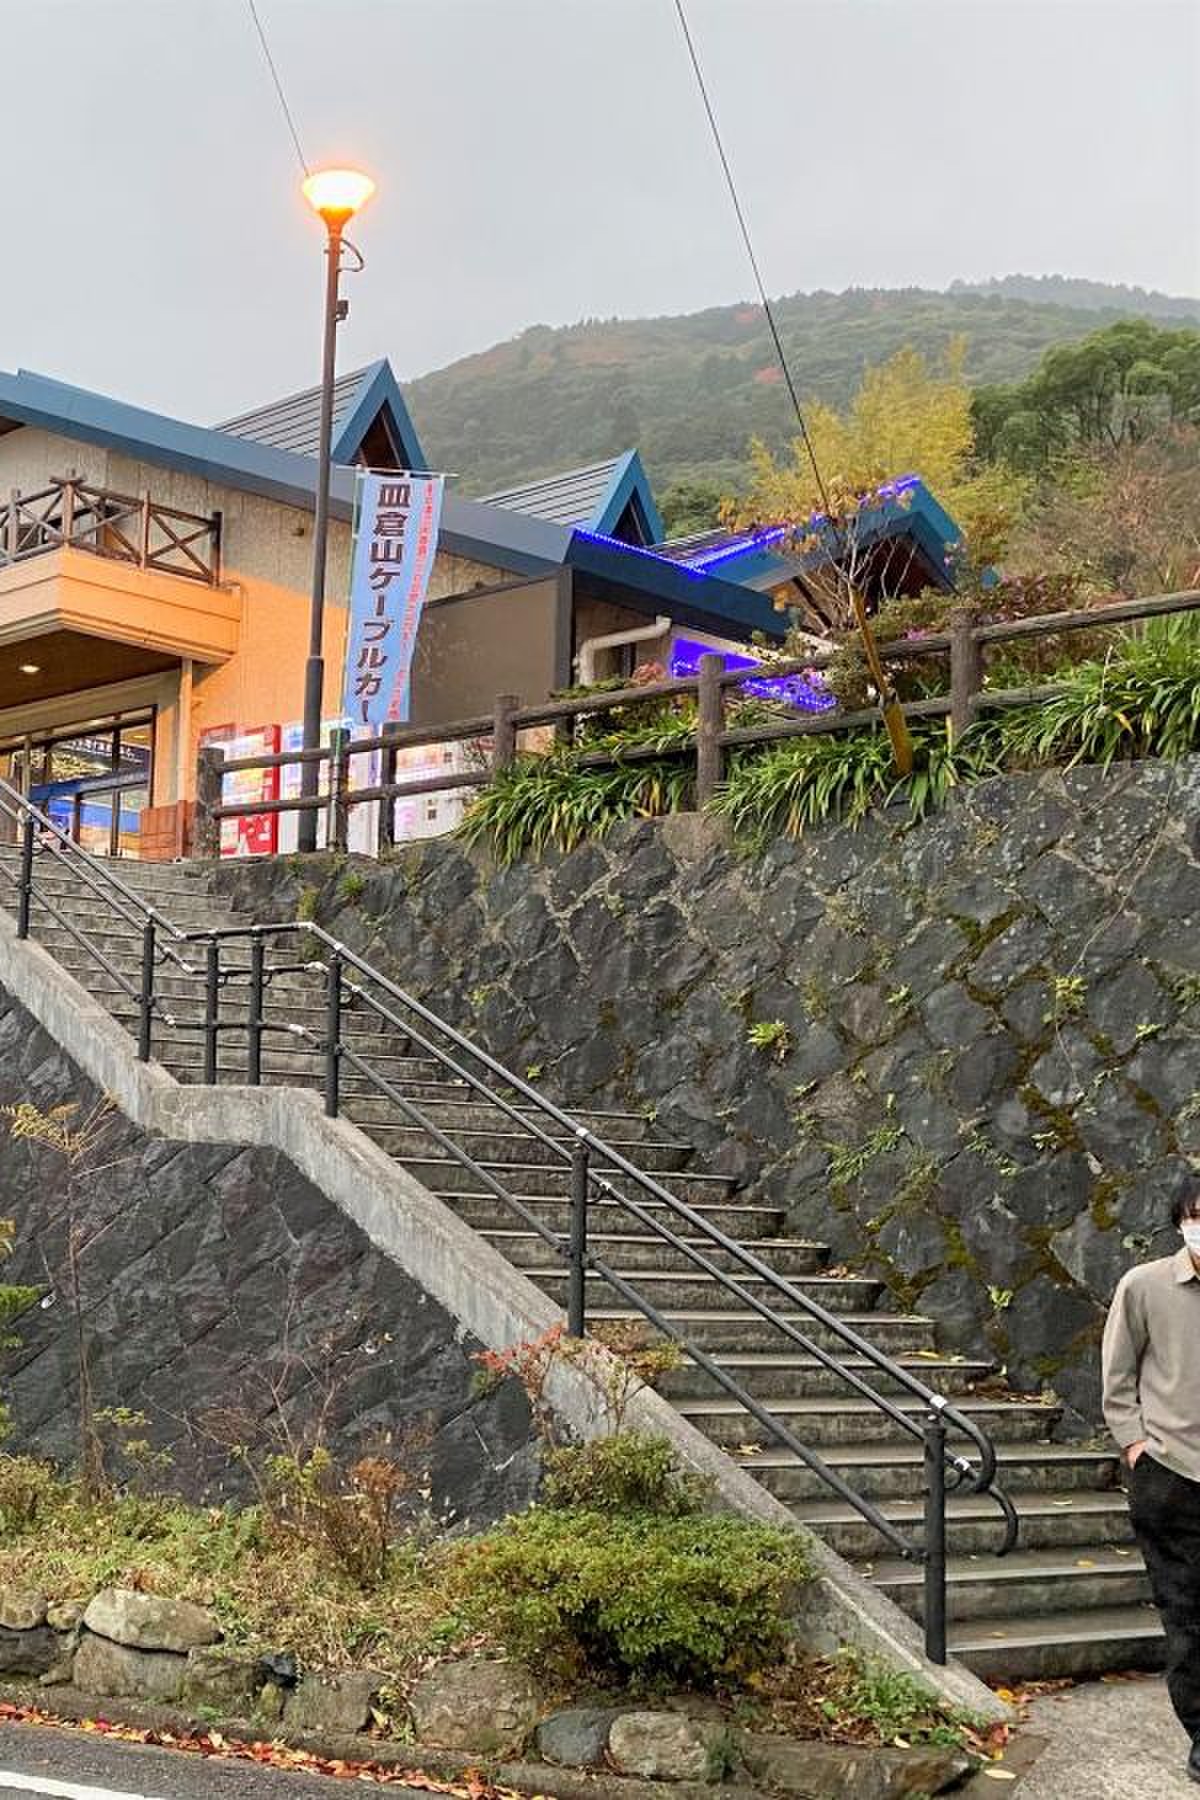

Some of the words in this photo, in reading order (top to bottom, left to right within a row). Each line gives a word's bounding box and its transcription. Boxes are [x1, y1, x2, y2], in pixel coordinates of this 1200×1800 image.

[355, 483, 411, 722] 皿倉山ケーブルカー
